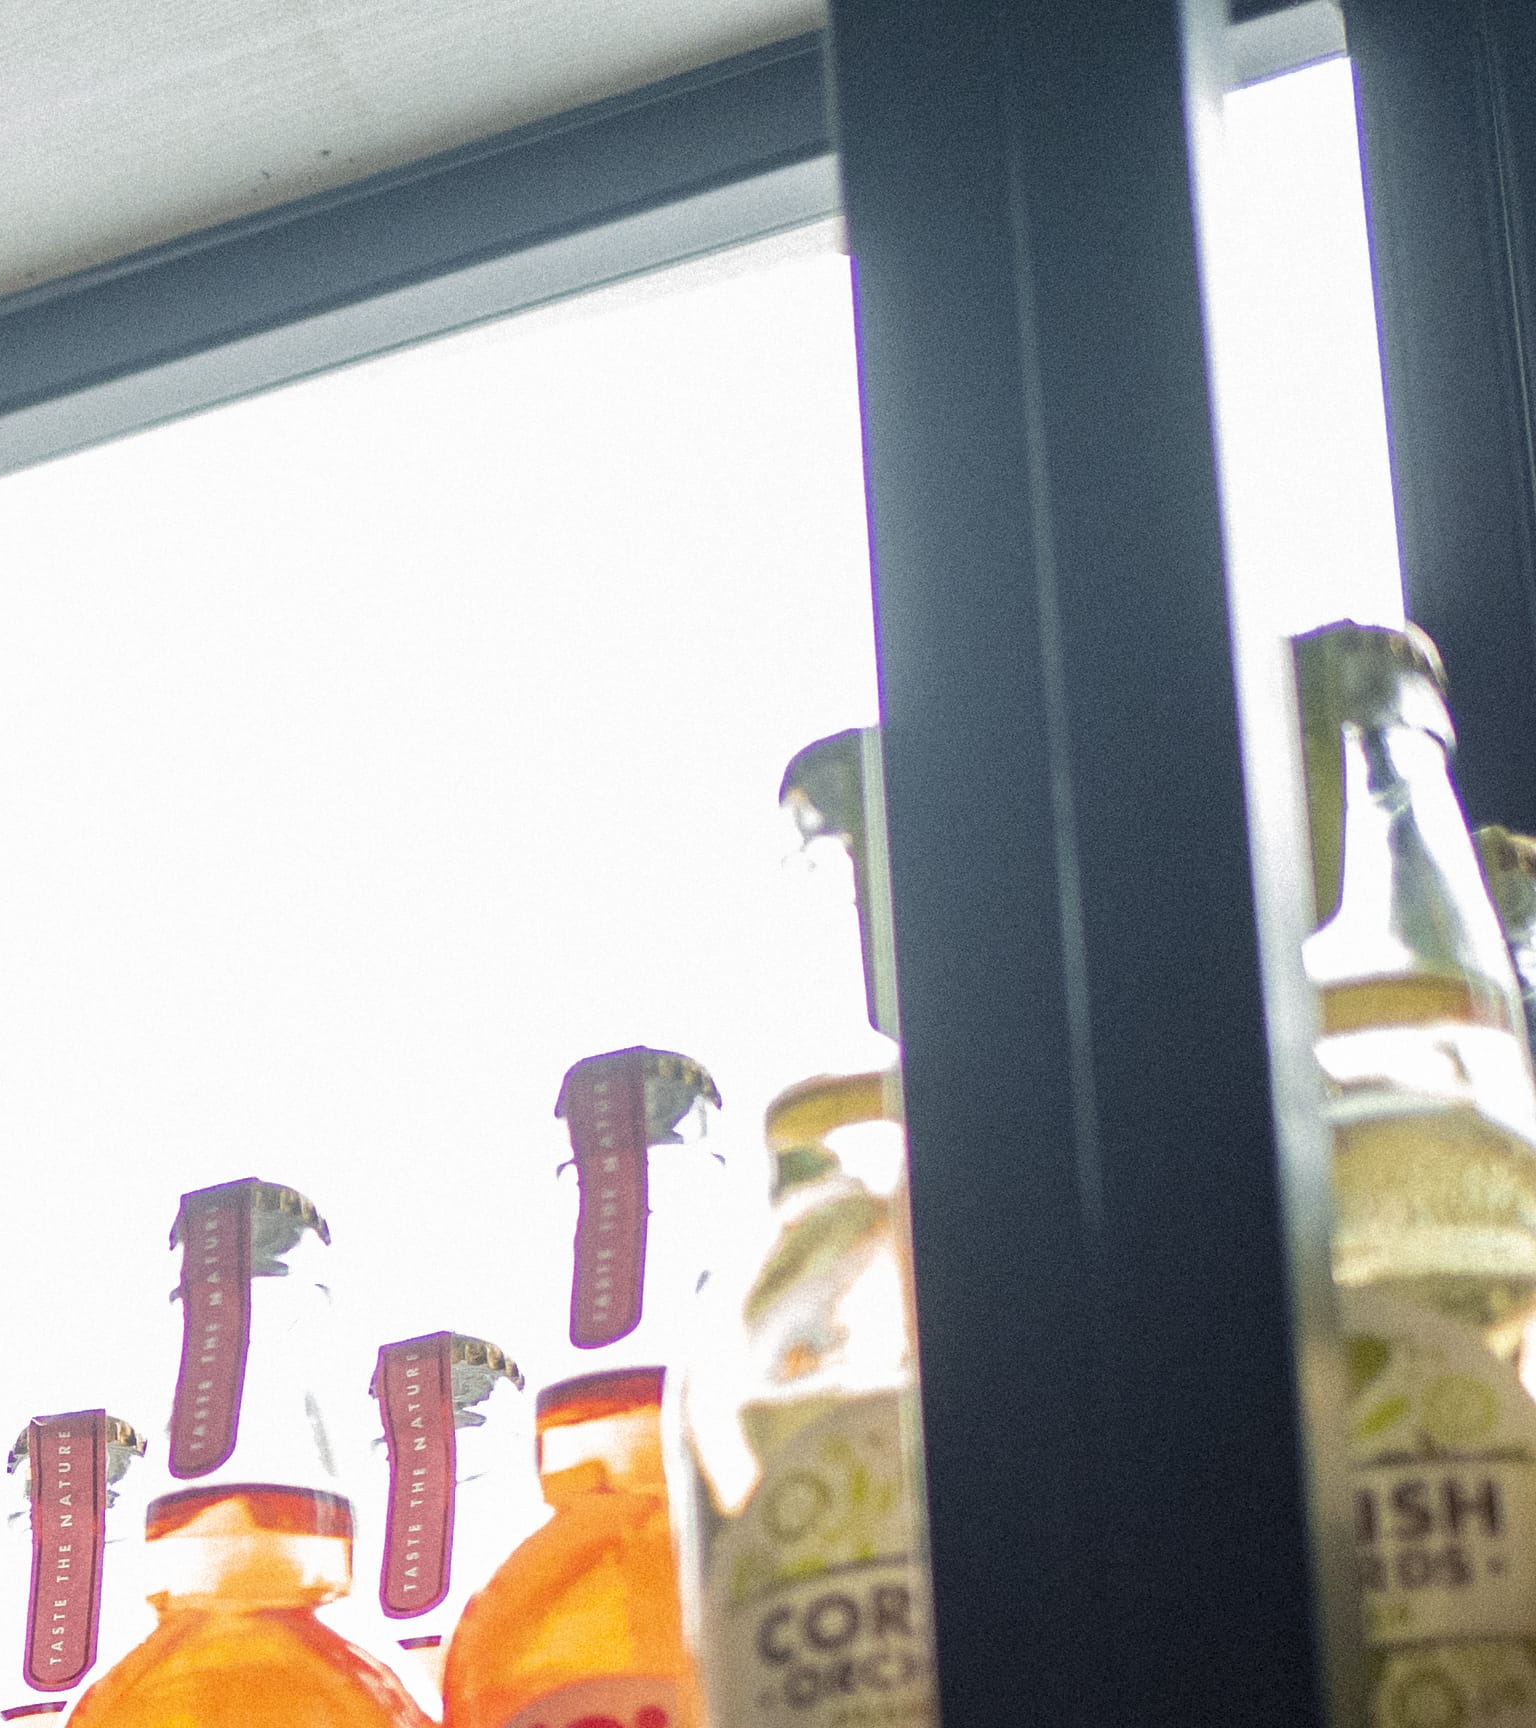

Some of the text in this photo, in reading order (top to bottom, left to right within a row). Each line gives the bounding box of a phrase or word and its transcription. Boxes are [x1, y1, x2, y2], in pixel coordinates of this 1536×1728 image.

[200, 1322, 221, 1364] THE
[48, 1429, 73, 1666] TASTE THE NATURE
[403, 1353, 428, 1593] TASTE THE NATURE
